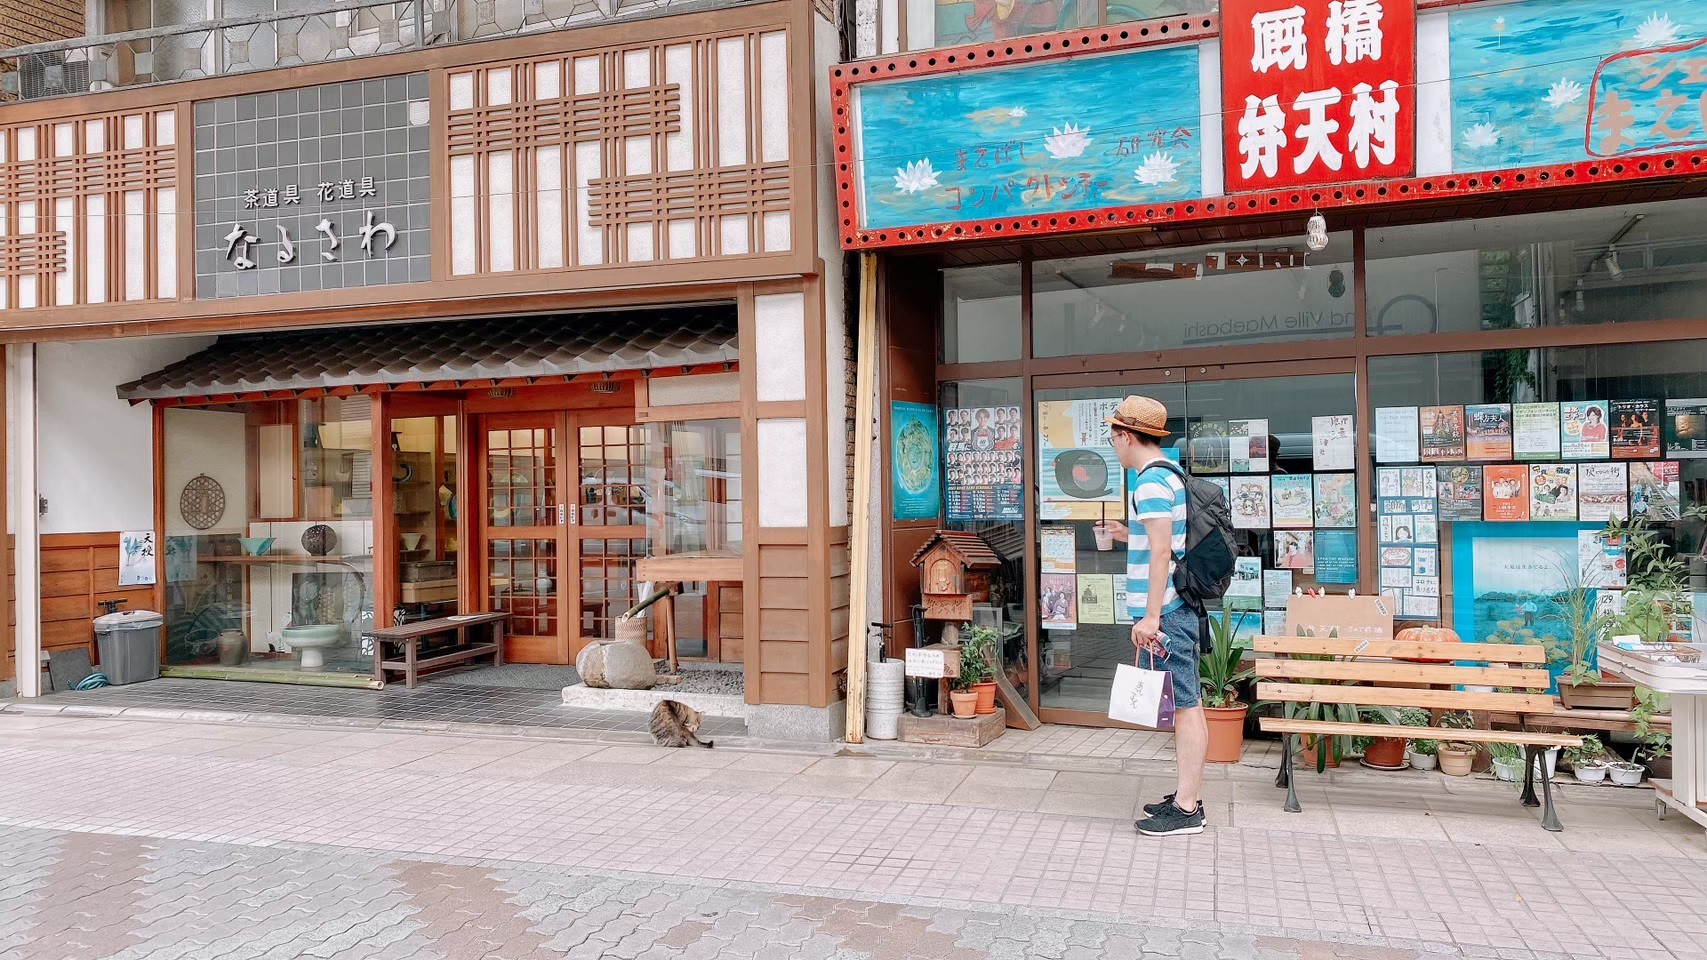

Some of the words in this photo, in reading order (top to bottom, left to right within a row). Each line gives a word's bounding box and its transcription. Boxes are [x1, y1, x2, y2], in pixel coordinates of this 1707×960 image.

[243, 184, 300, 209] 茶道具
[316, 176, 376, 202] 花道具
[223, 210, 399, 270] なるさわ
